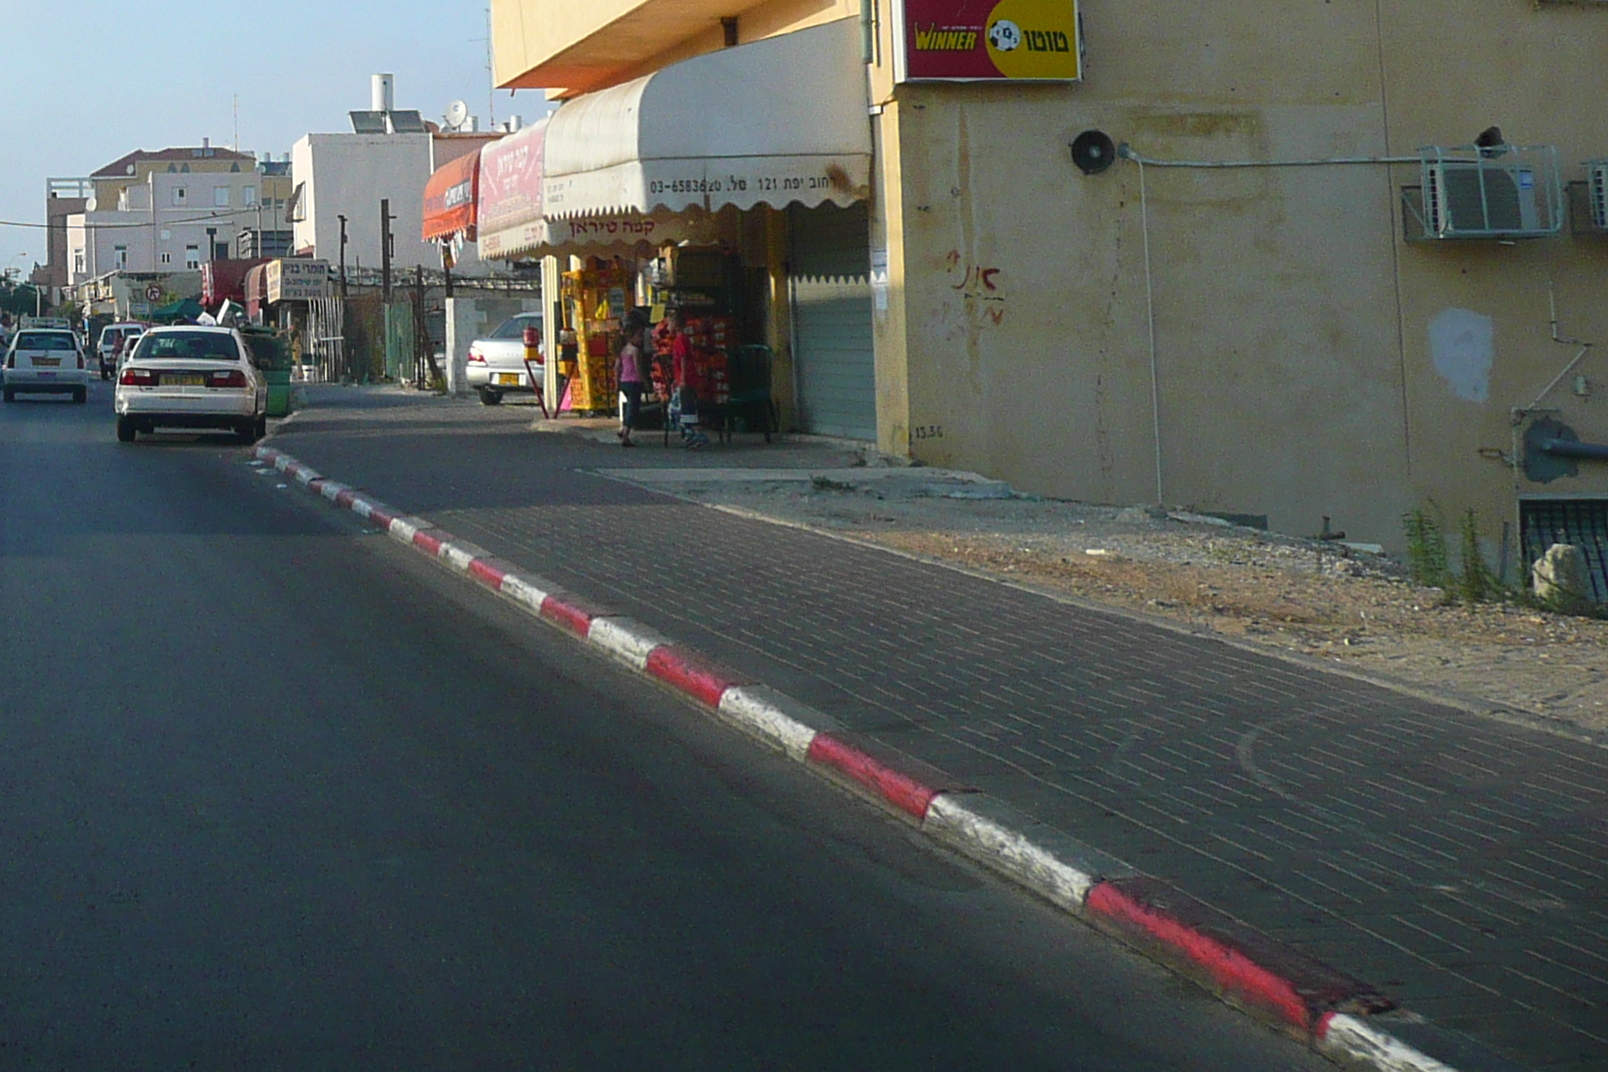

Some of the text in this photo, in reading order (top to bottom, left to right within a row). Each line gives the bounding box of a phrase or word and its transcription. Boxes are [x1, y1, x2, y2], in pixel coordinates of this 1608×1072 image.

[914, 22, 977, 50] WINNER
[1023, 30, 1069, 52] טוטו
[784, 176, 804, 190] יפת
